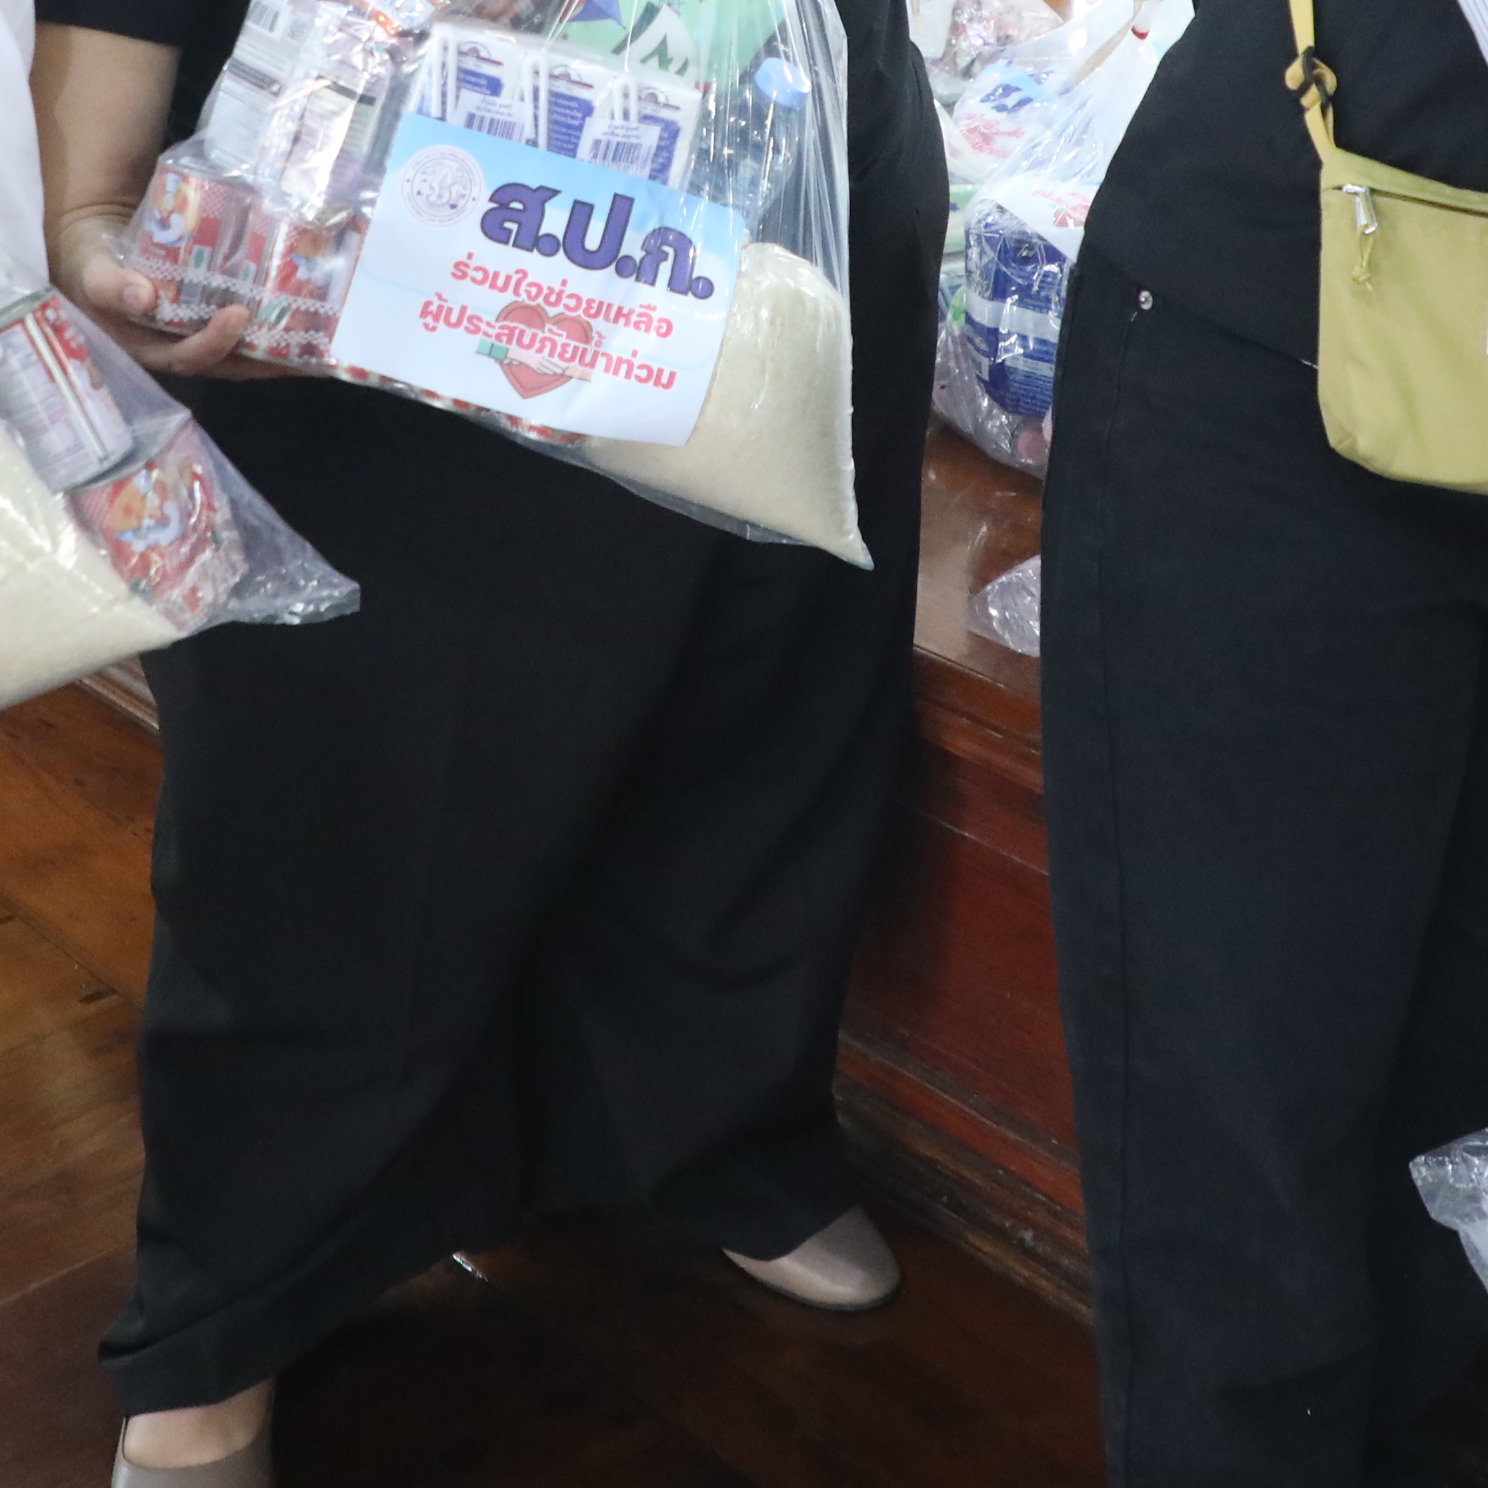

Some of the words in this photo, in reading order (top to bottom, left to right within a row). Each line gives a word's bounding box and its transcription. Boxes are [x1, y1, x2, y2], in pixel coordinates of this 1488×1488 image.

[479, 181, 715, 300] ส.ป.ก.
[419, 292, 678, 391] ผู้ประสบภัยน้ำท่วม
[450, 251, 674, 338] ร่วมใจช่วยเหลือ
